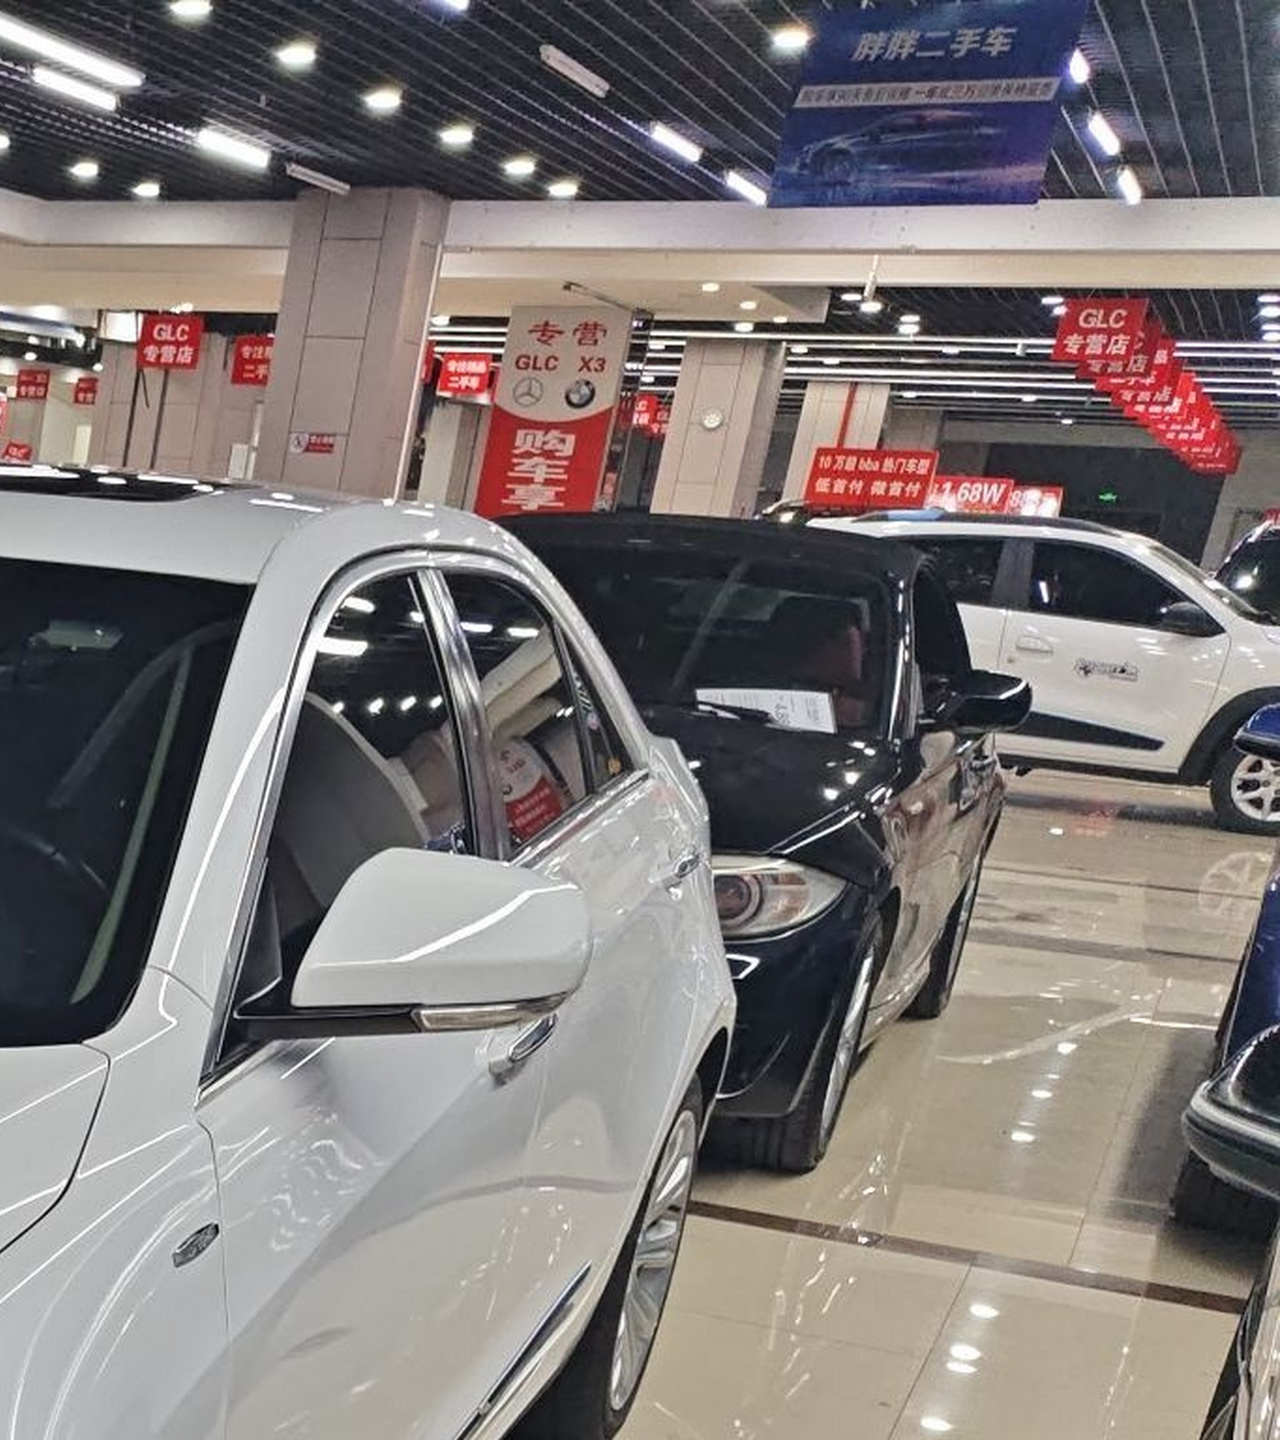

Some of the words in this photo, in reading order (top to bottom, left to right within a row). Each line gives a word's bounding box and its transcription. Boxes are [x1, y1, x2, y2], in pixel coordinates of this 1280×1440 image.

[1078, 308, 1128, 329] GLC
[152, 323, 190, 342] GLC
[1063, 333, 1131, 356] 专营店
[143, 345, 194, 364] 专营店
[515, 354, 560, 372] GLC
[577, 356, 607, 373] X3
